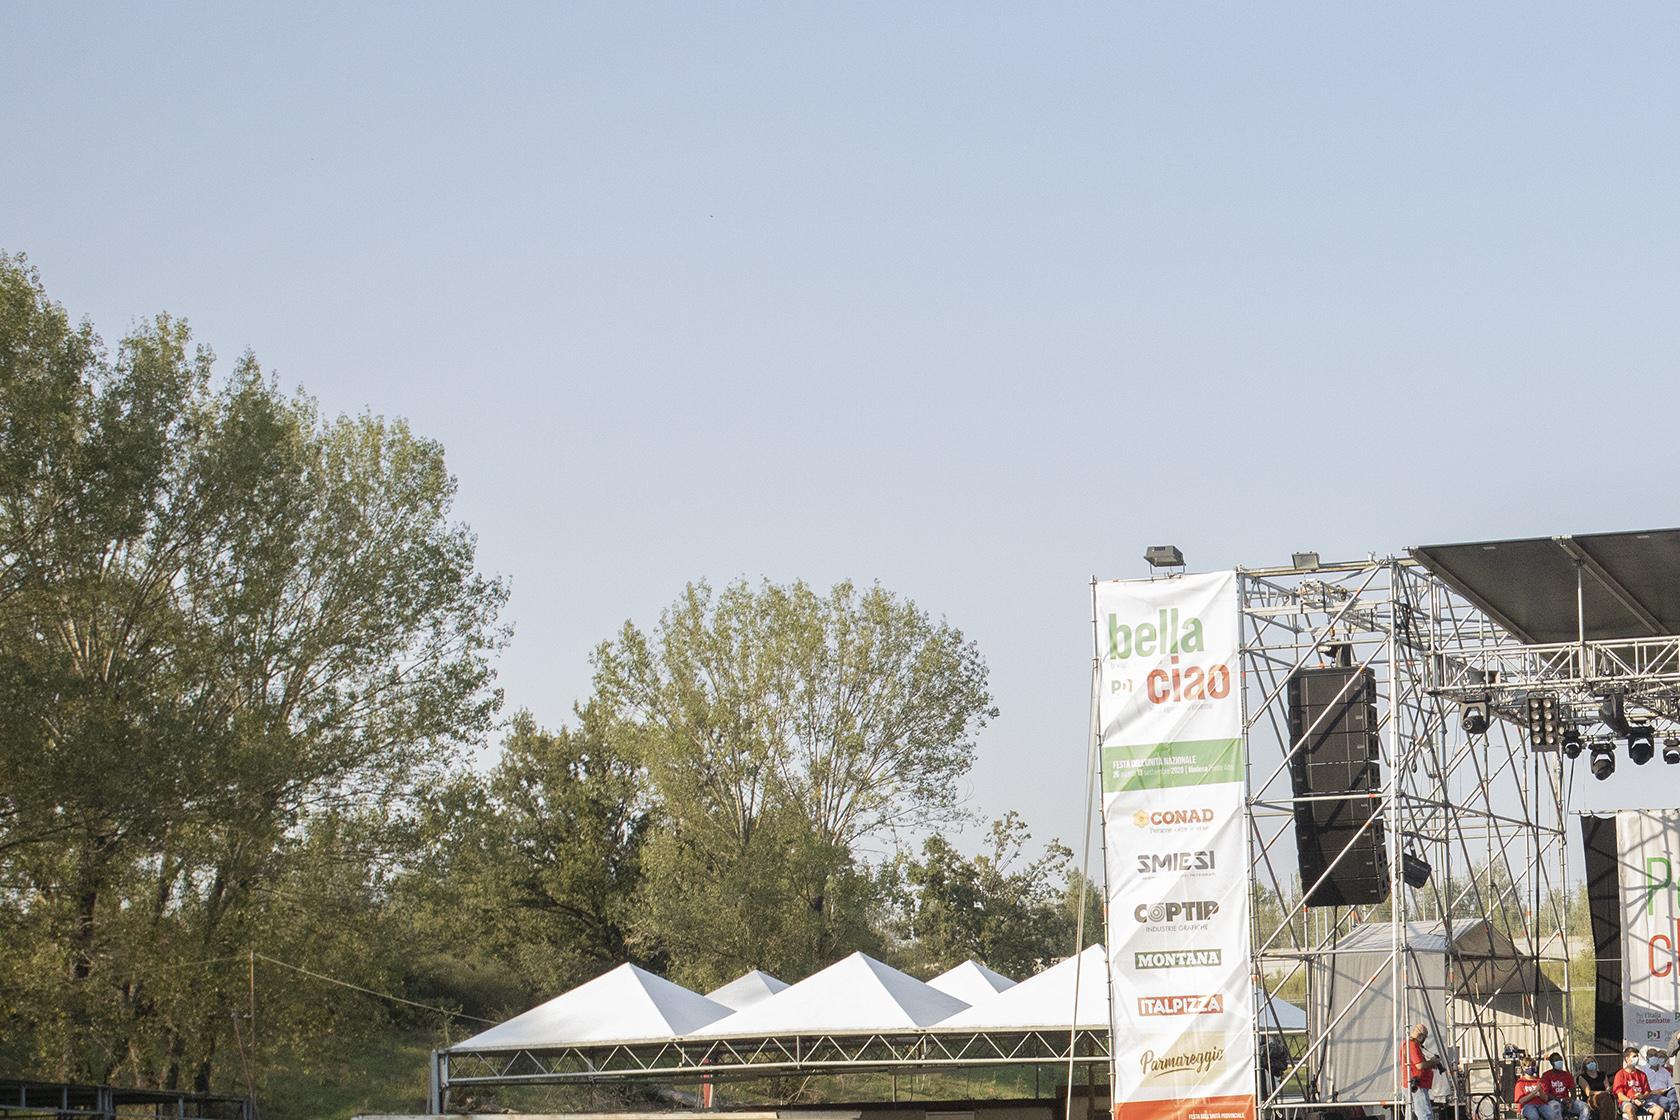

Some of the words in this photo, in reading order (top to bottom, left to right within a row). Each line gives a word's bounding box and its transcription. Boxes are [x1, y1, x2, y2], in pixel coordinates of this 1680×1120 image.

[1108, 607, 1205, 660] bella
[1146, 655, 1231, 705] ciao
[1151, 808, 1214, 825] CONAD
[1146, 924, 1177, 933] INDUSTRIE
[1178, 923, 1208, 932] GRAFICHE
[1137, 951, 1220, 968] MONTANA
[1141, 994, 1221, 1014] ITALPIZZA
[1140, 1045, 1225, 1075] Parmareggio
